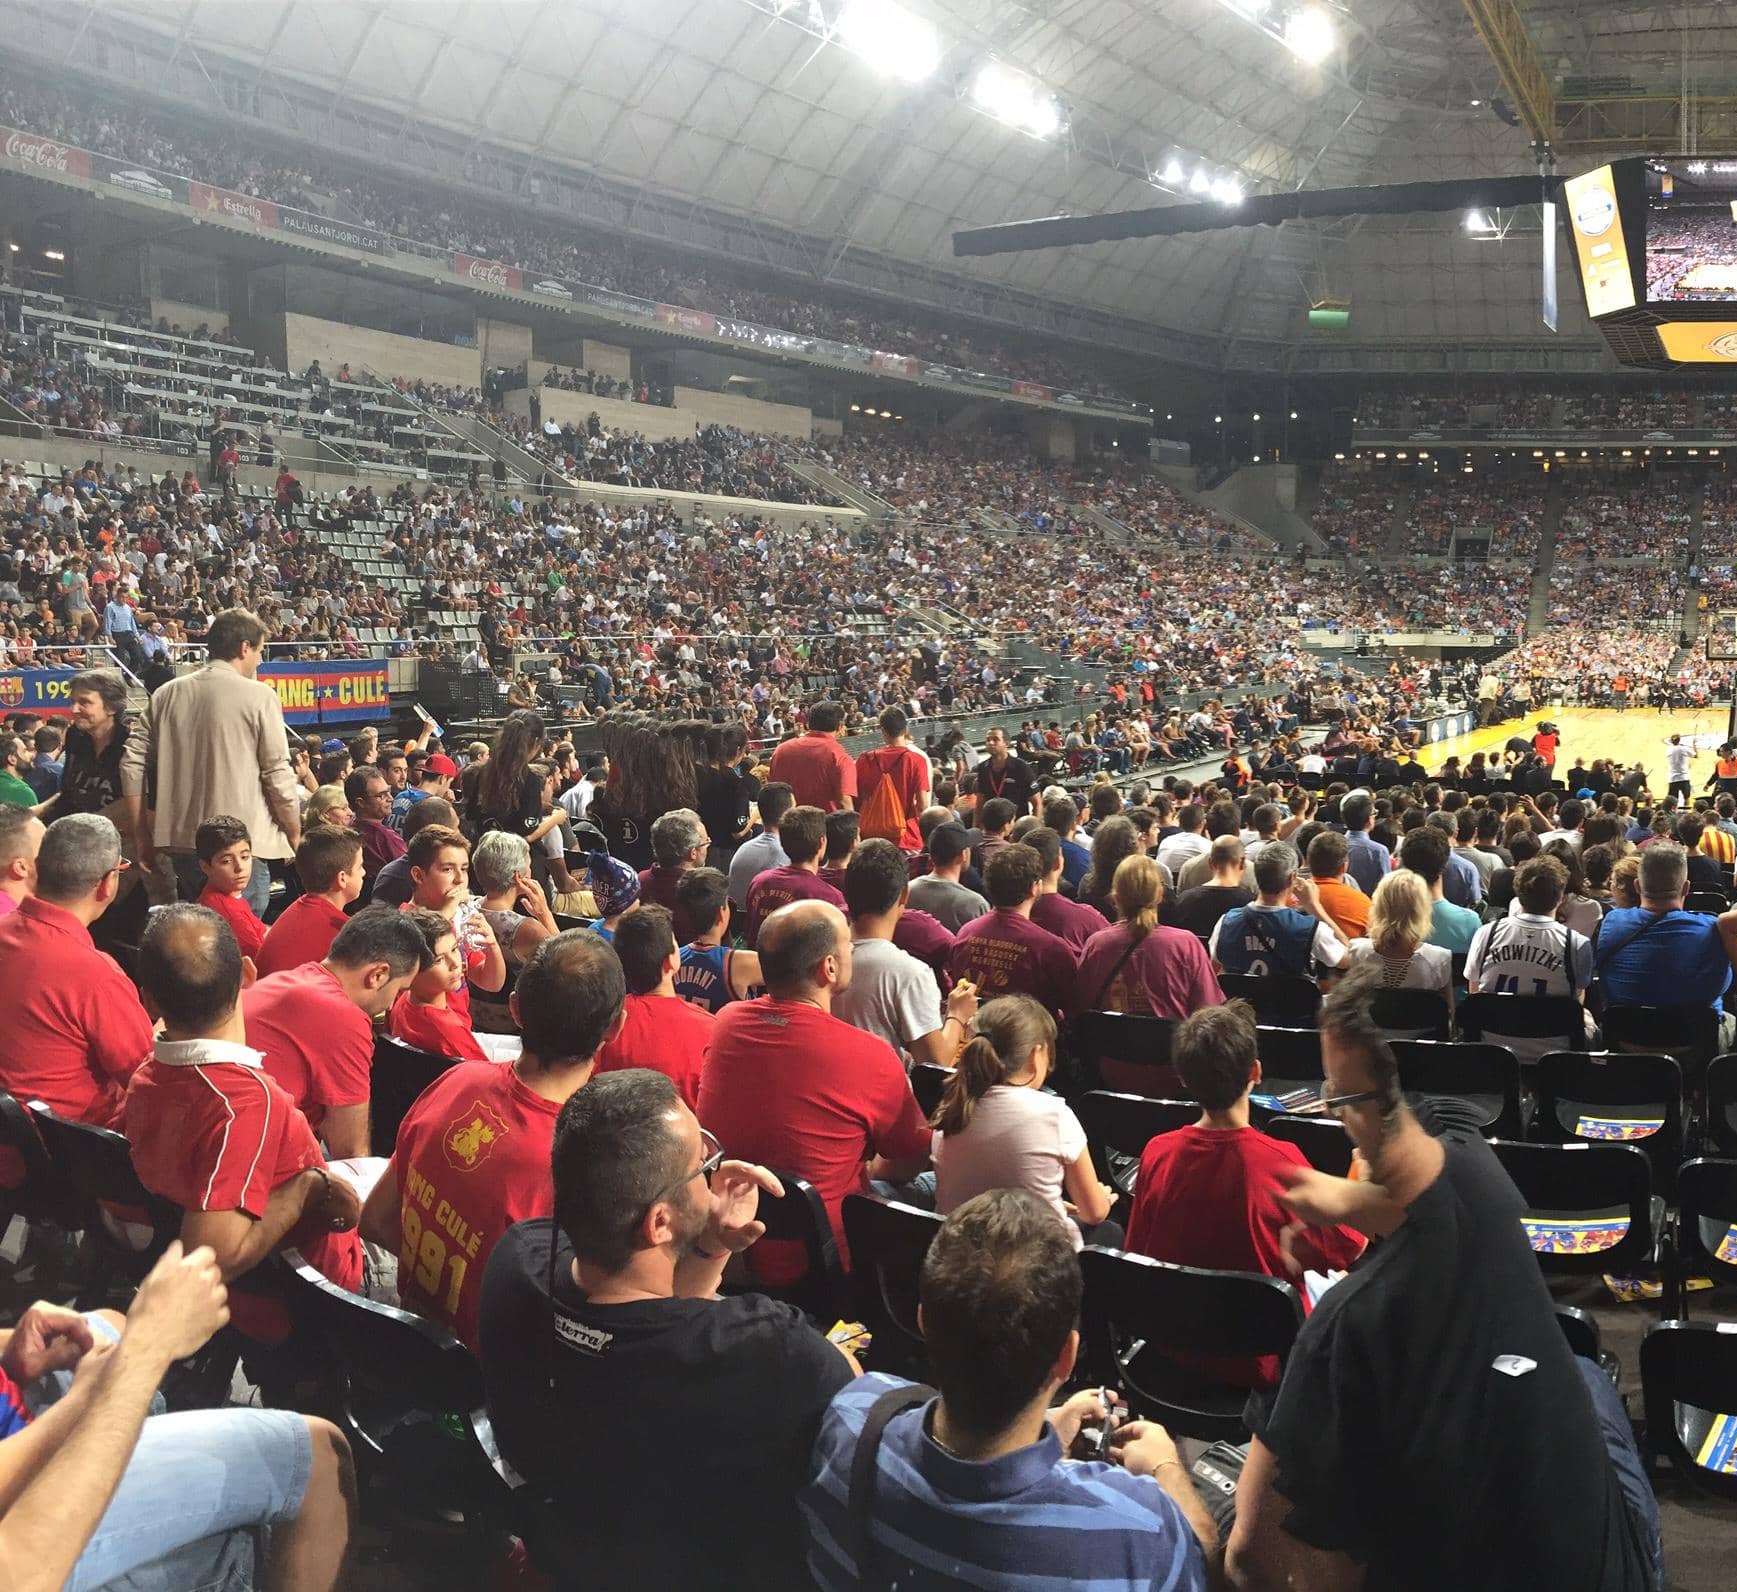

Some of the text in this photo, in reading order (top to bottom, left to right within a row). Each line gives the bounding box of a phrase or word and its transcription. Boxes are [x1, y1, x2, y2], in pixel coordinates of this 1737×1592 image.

[223, 198, 262, 221] Estrella
[35, 680, 72, 701] 199
[262, 671, 386, 707] ANG CULÉ
[1491, 944, 1563, 972] NOWITZKI
[435, 1200, 484, 1259] CULÉ
